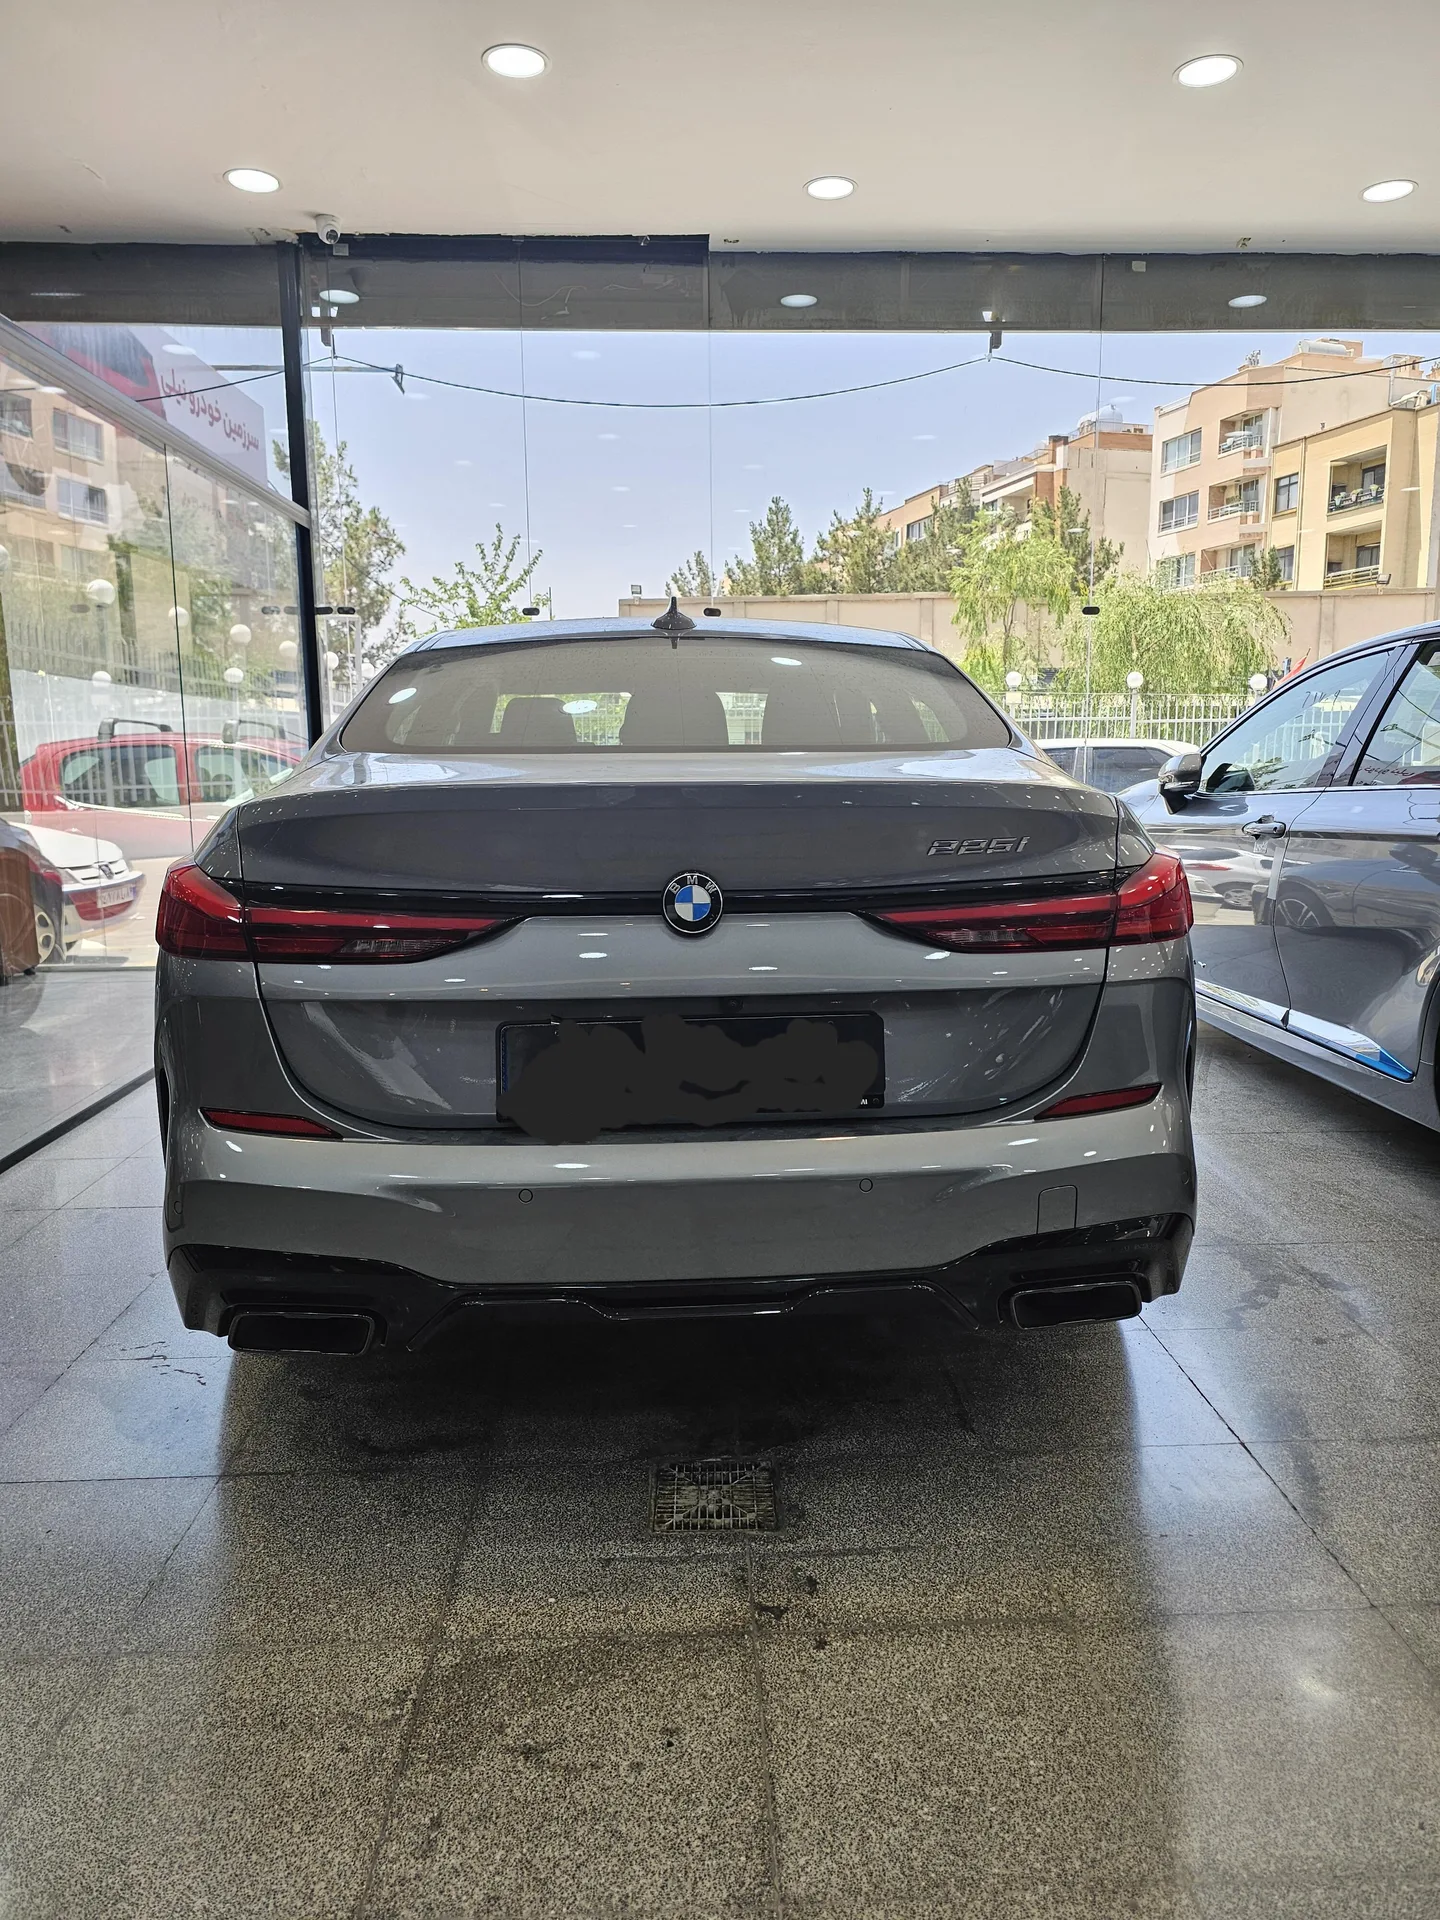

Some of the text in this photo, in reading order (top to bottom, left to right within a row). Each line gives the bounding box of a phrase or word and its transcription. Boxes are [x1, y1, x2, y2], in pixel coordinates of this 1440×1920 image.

[188, 390, 222, 428] خودرو
[223, 412, 260, 451] سرزمین
[927, 836, 1031, 856] 225i
[668, 875, 718, 895] BMW
